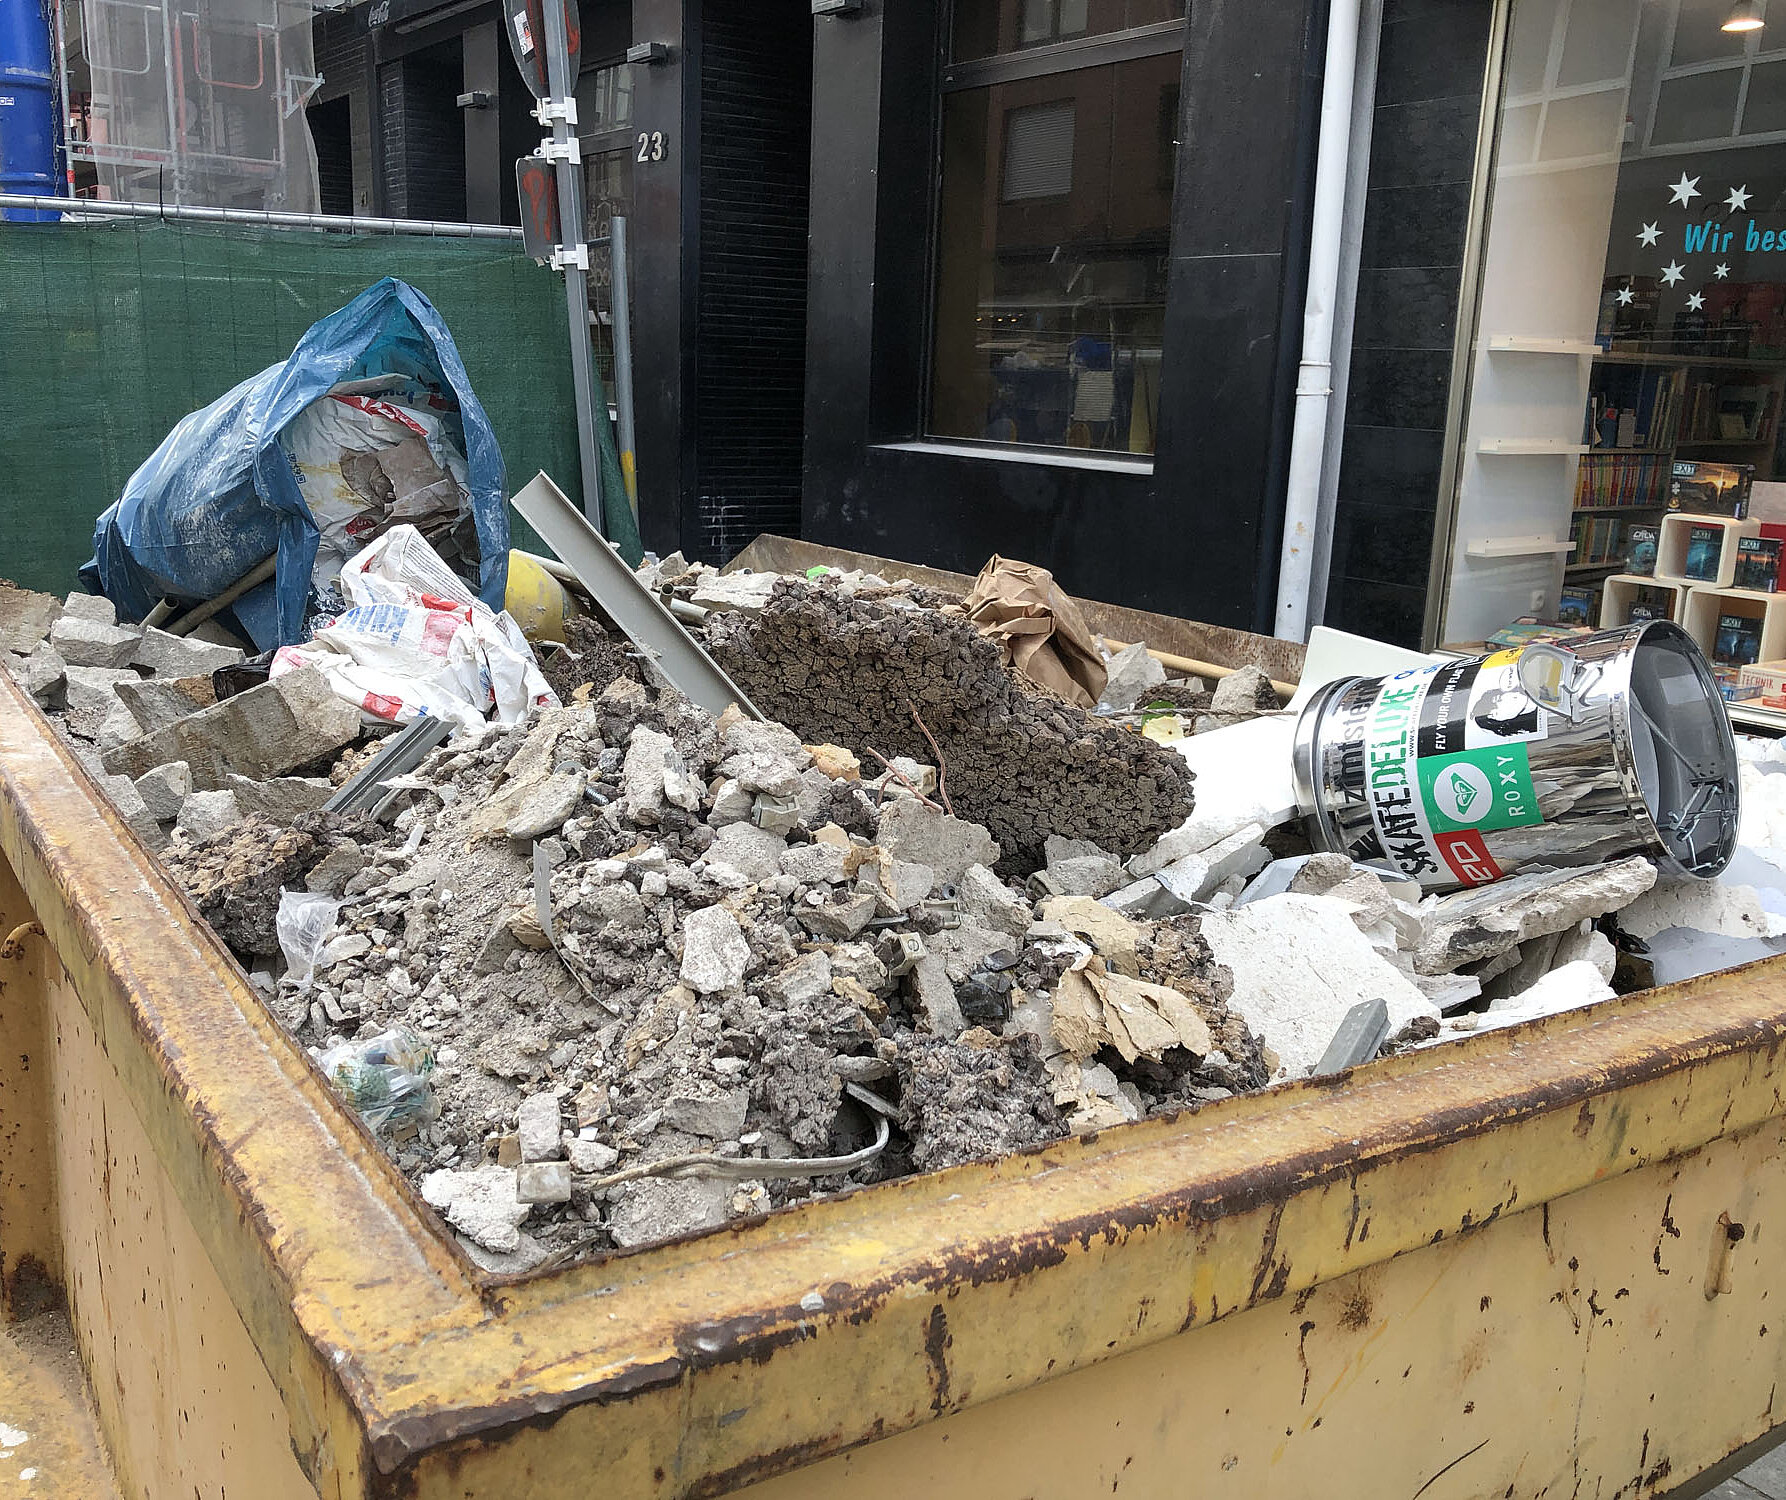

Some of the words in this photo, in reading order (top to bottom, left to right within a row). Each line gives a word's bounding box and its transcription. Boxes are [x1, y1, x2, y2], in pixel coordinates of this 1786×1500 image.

[637, 131, 662, 163] 23
[1685, 220, 1734, 254] Wir
[1674, 463, 1695, 474] EXIT
[1741, 538, 1760, 549] EXIT
[1442, 681, 1456, 705] OWN
[1742, 674, 1774, 689] TECHNIK
[1436, 705, 1450, 730] YOUR
[1435, 734, 1447, 751] FLY
[1496, 755, 1526, 818] ROXY
